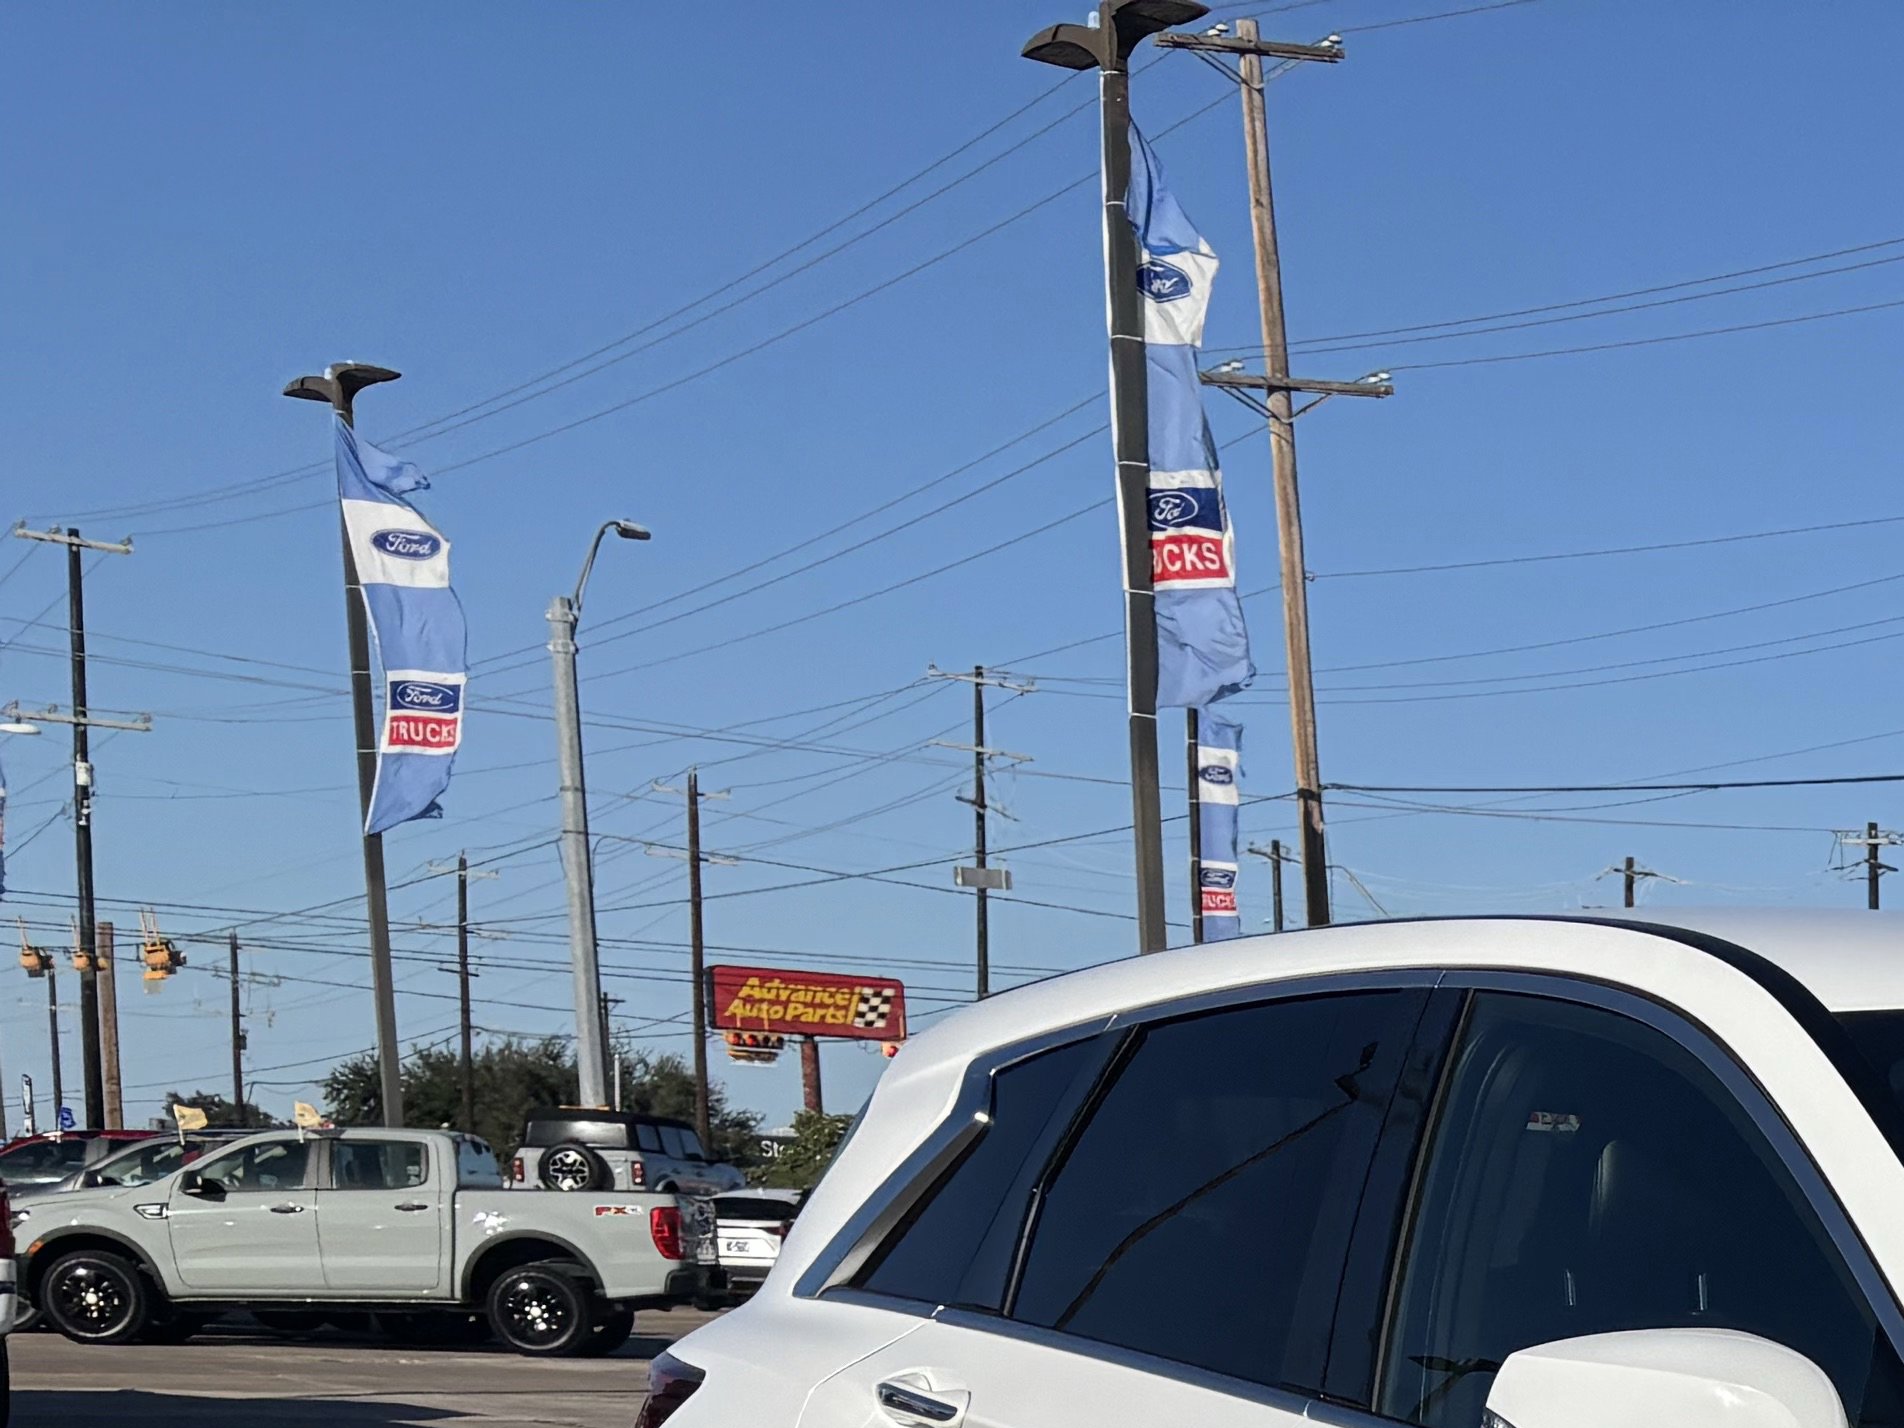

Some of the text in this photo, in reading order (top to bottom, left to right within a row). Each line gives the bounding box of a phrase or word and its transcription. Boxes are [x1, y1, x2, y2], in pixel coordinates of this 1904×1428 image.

[385, 532, 432, 554] Ford
[404, 686, 442, 705] Ford
[738, 977, 850, 1005] Advance
[724, 999, 846, 1024] Auto Parts
